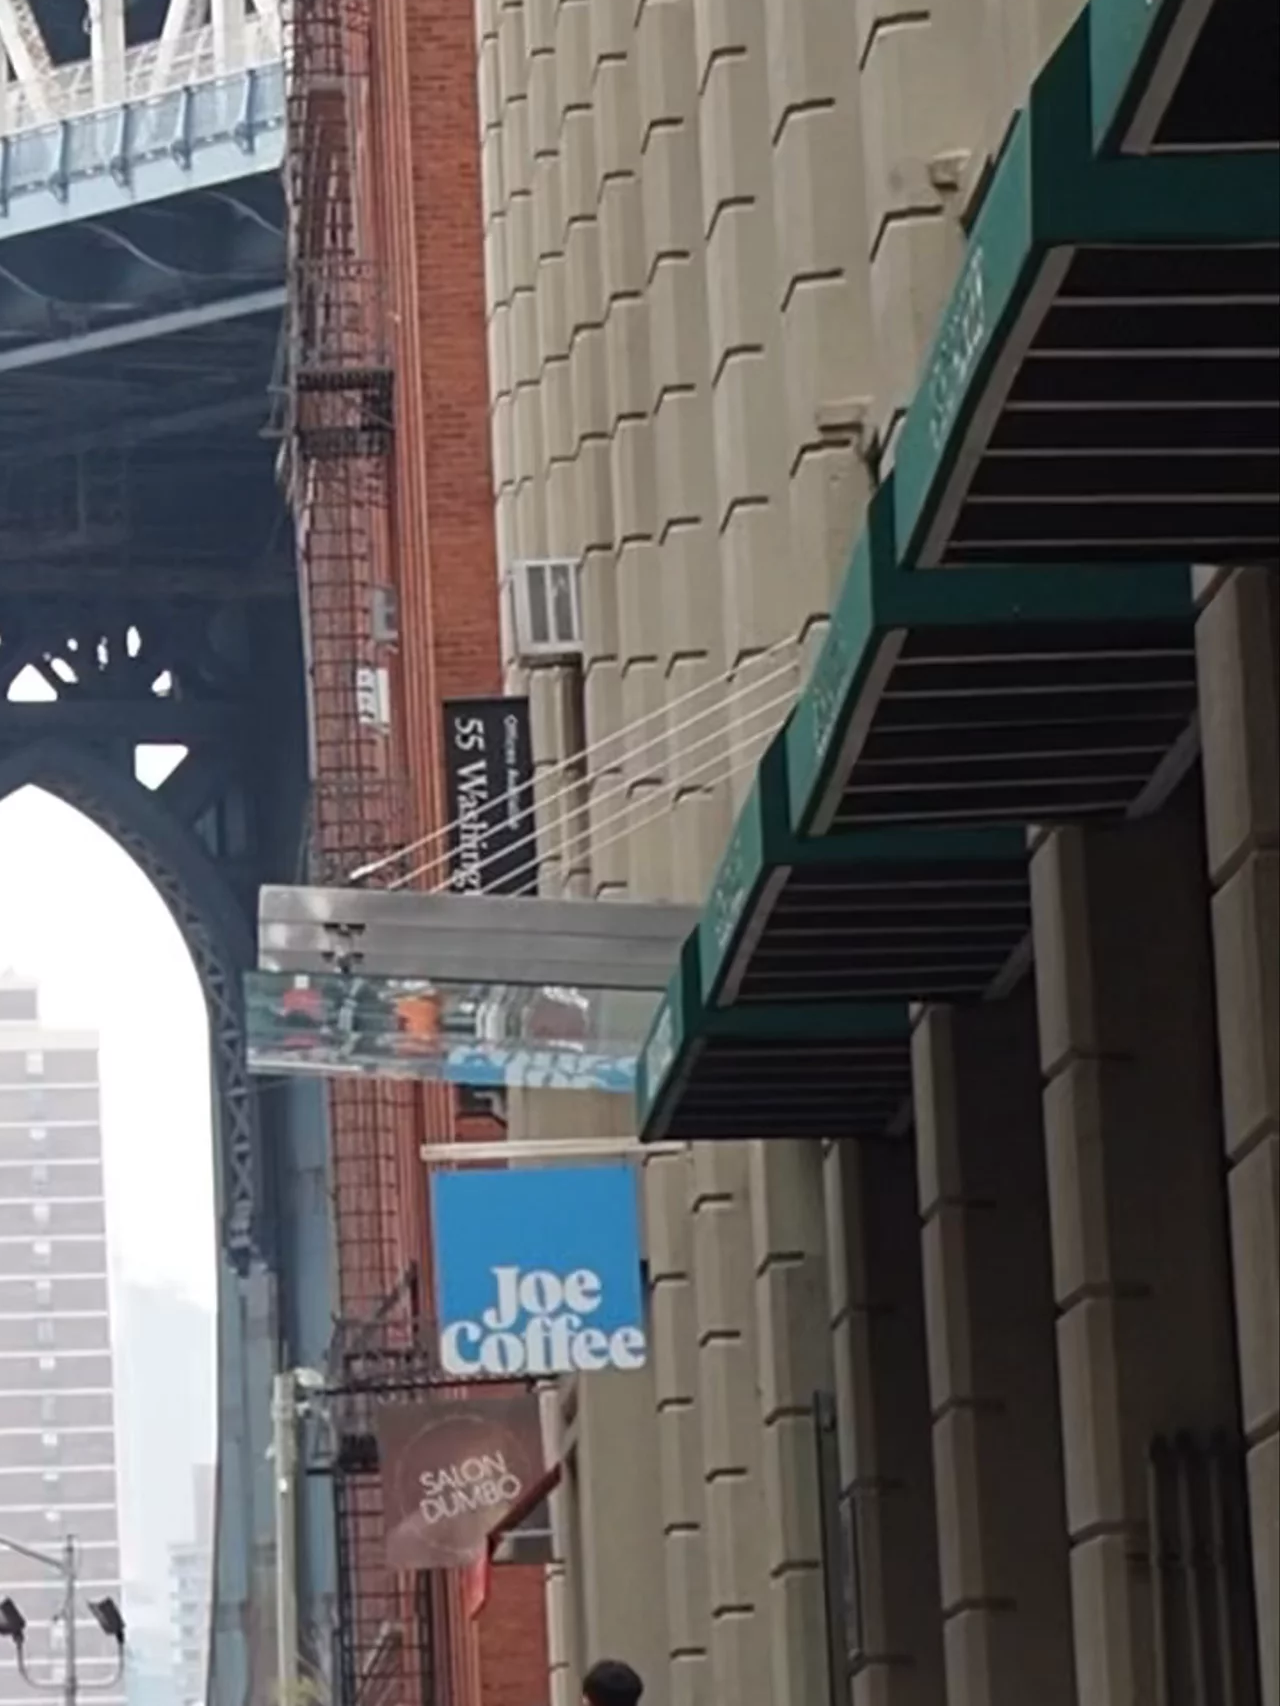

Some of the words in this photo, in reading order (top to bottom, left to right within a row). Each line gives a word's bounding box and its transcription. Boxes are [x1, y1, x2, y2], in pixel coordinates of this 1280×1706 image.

[454, 716, 486, 752] 55
[483, 1265, 602, 1329] Joe
[441, 1313, 647, 1375] Coffee
[419, 1450, 508, 1496] SALON
[419, 1473, 521, 1524] DUMBO
